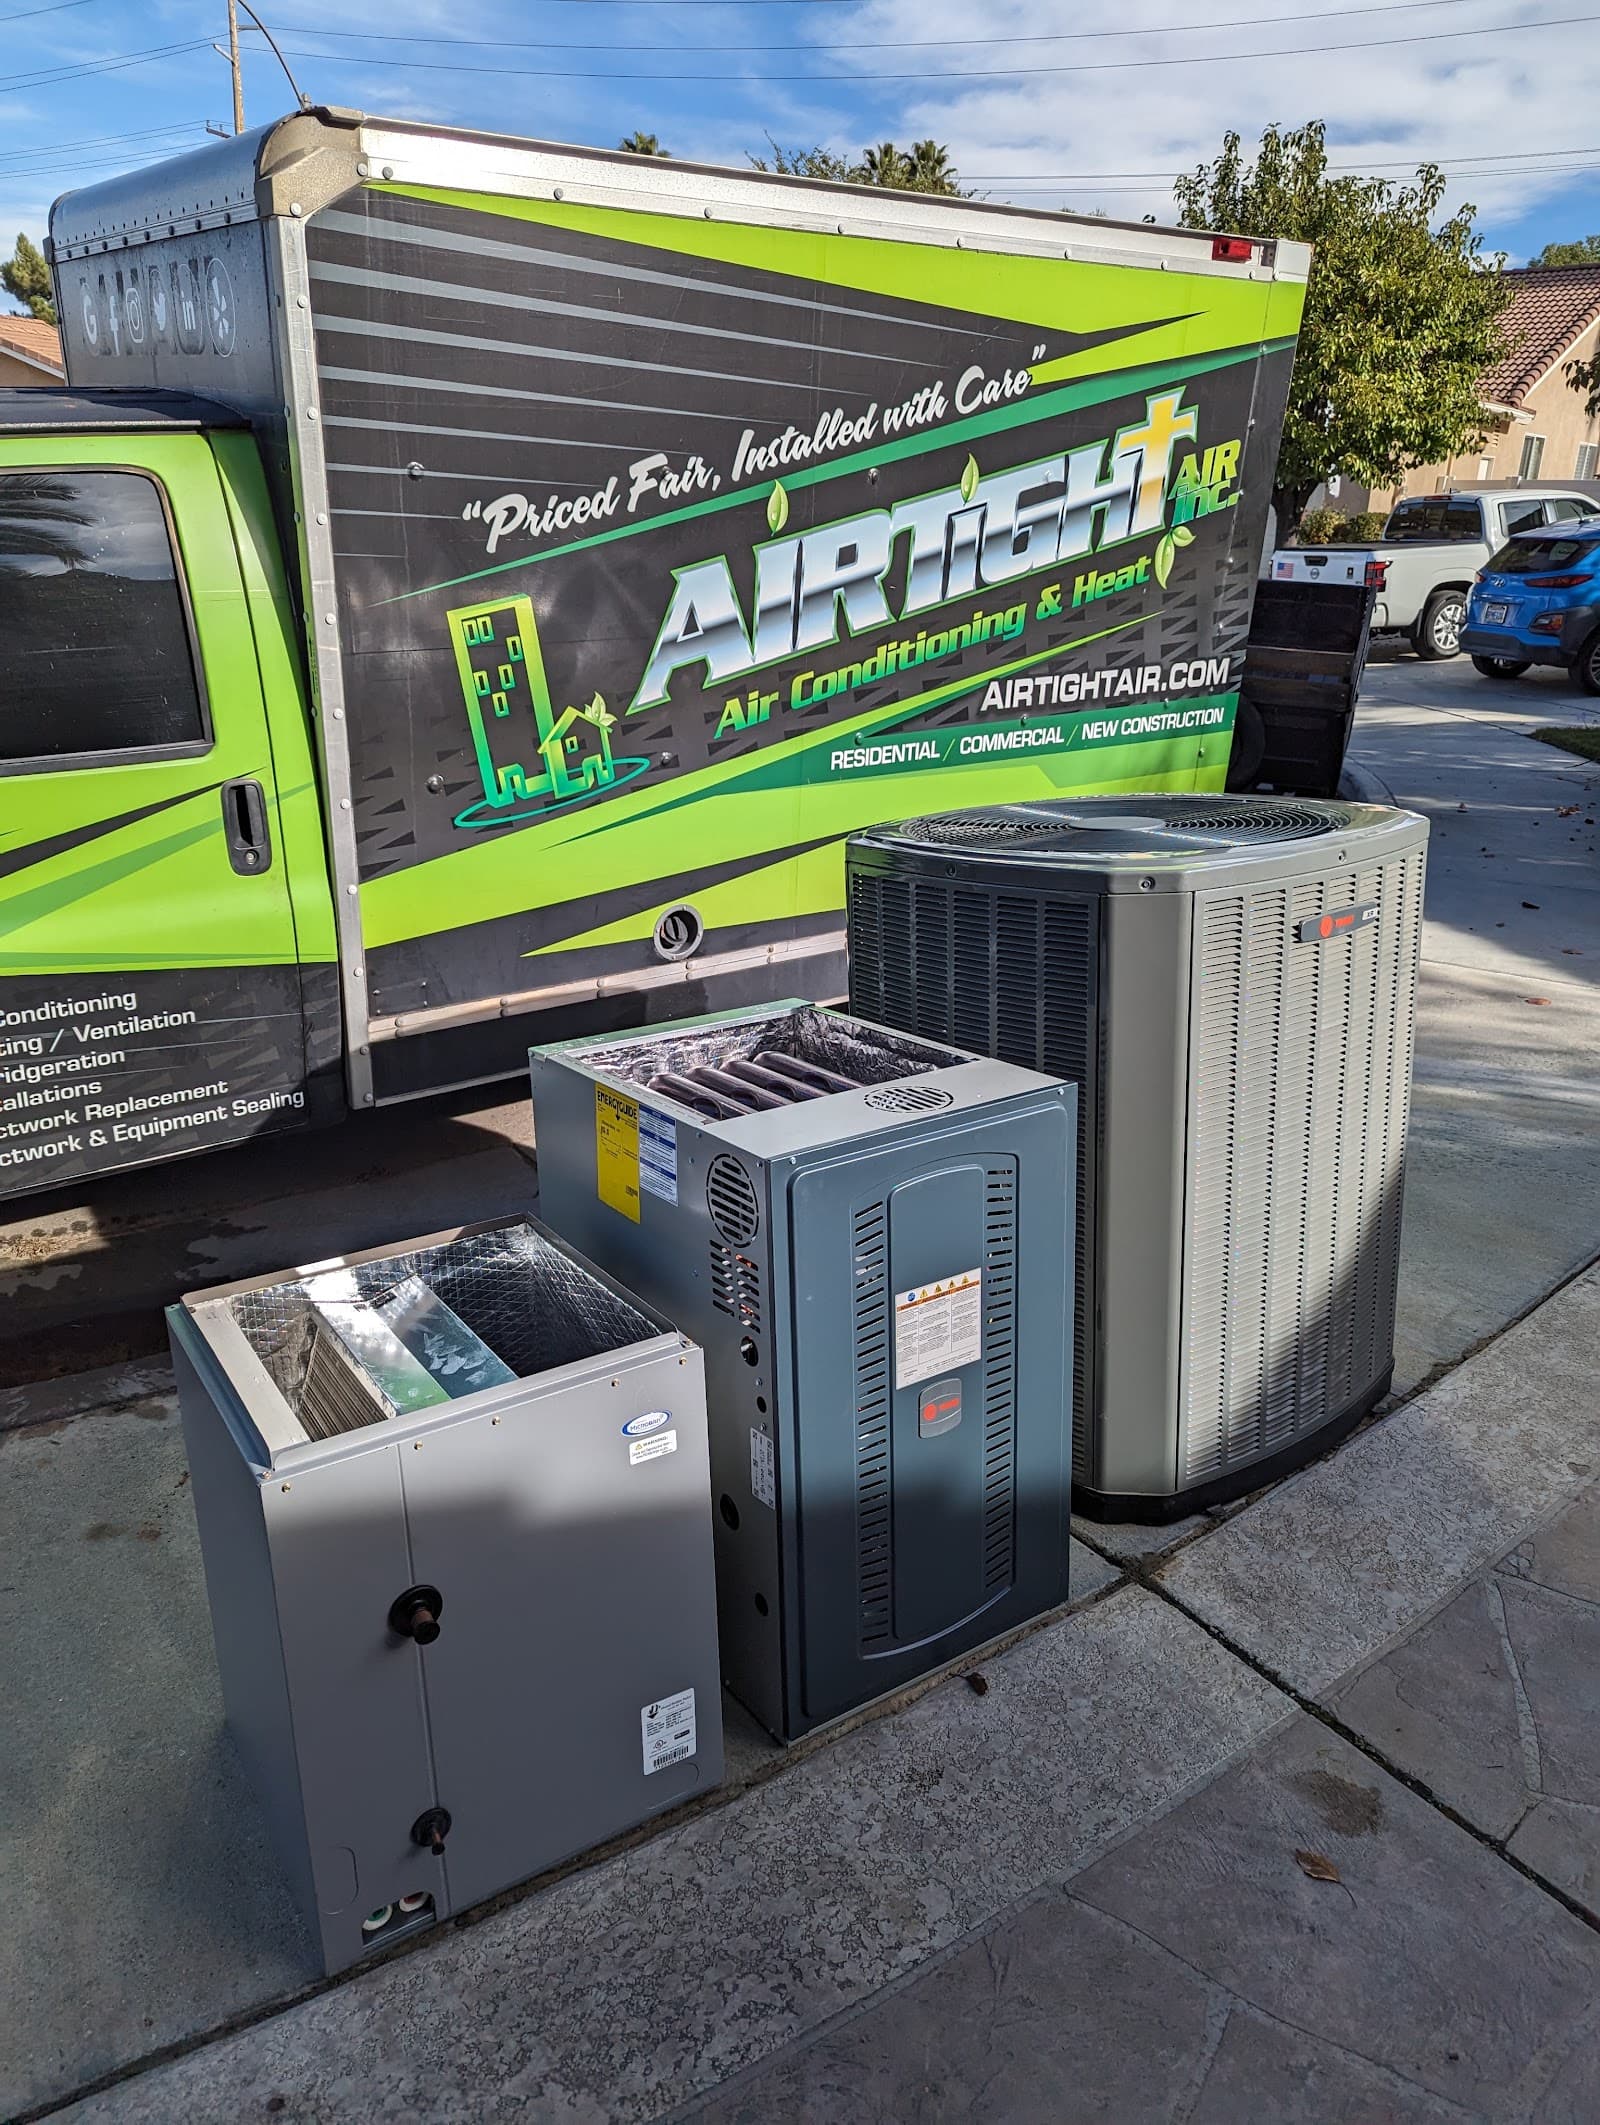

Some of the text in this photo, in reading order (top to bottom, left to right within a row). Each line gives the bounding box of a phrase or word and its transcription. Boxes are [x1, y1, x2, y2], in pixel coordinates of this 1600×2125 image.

[627, 453, 721, 513] Fair,
[732, 403, 878, 482] Installed
[883, 380, 949, 434] with
[1168, 439, 1241, 501] AIR
[713, 554, 1151, 740] Air Conditioning & Heat
[980, 656, 1232, 713] AIRTIGHTAIR.COM
[830, 739, 941, 771] RESIDENTIAL
[959, 726, 1065, 756] COMMERCIAL
[1081, 720, 1118, 741] NEW
[1120, 707, 1224, 737] CONSTRUCTION
[72, 1009, 196, 1043] Ventilation
[0, 1090, 305, 1167] ctwork & Equipment Sealing
[84, 1079, 229, 1121] Replacement
